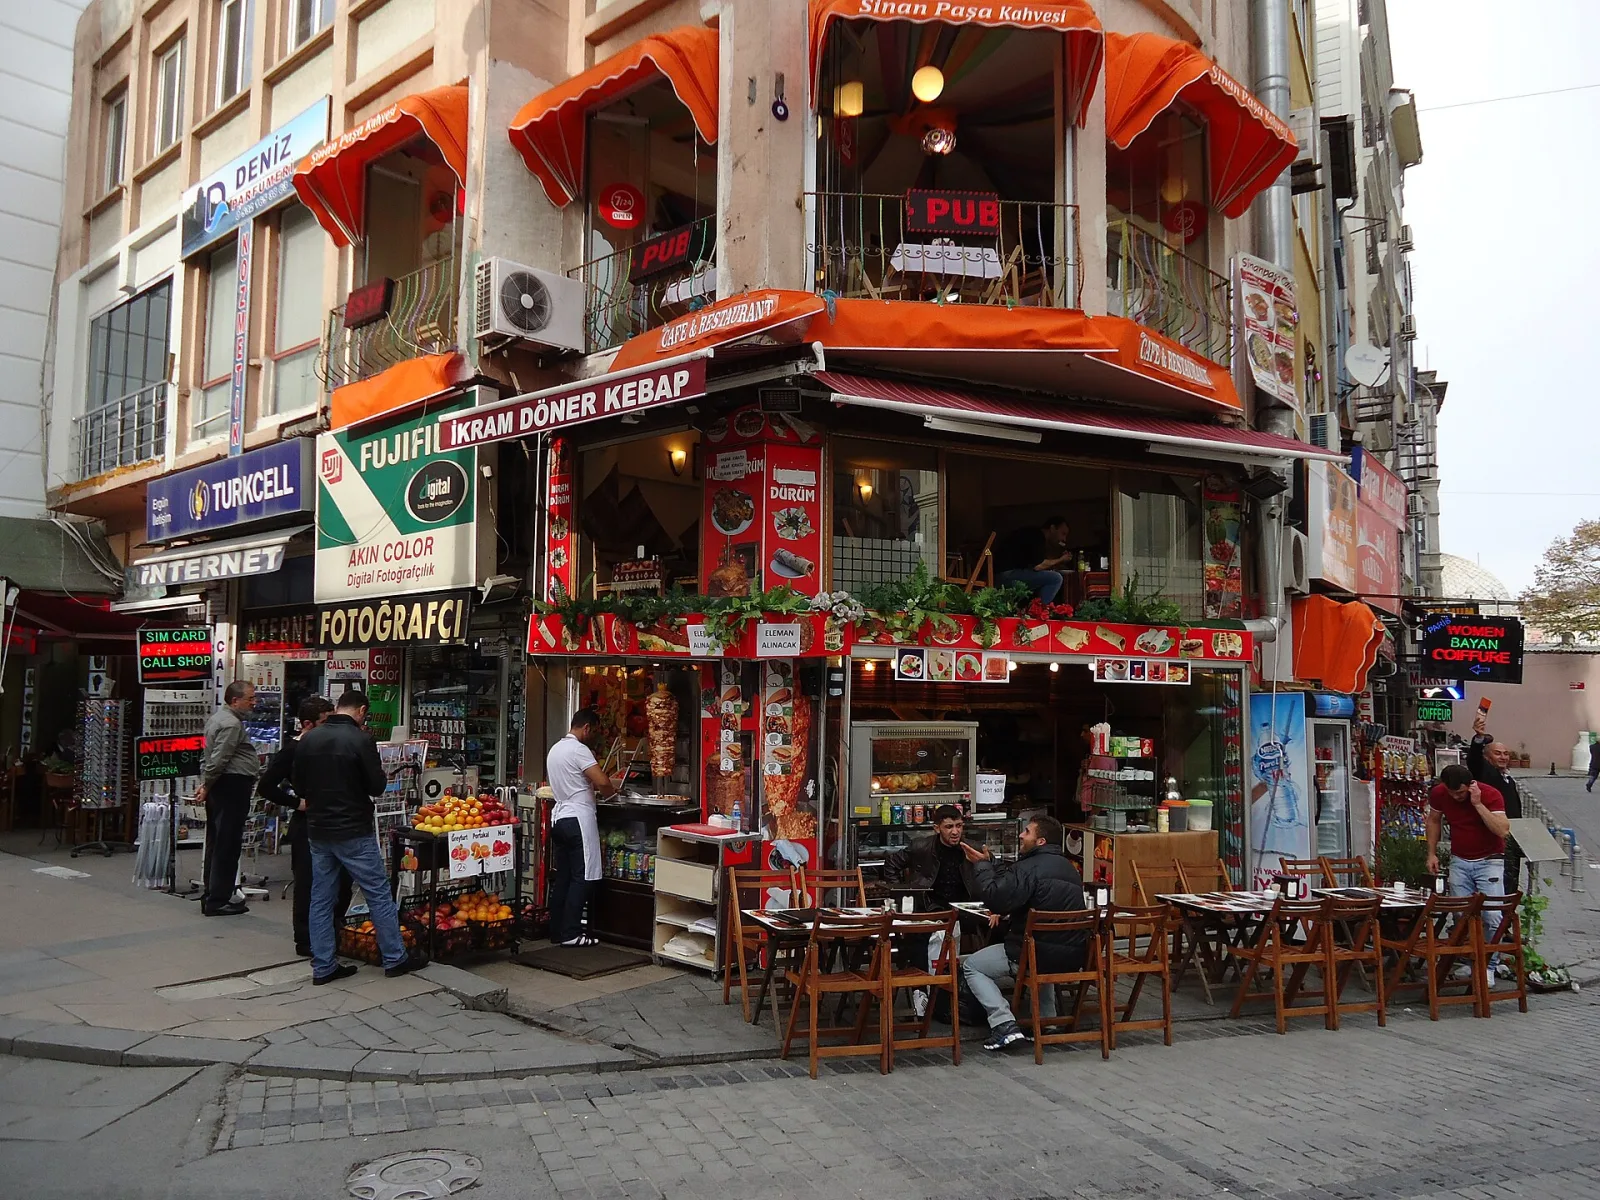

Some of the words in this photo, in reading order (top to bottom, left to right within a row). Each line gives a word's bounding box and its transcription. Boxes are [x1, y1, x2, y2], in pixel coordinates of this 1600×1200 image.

[858, 0, 927, 15] Sinan
[934, 1, 991, 20] Paşa
[999, 6, 1067, 23] Kahvesi
[1212, 65, 1240, 94] Sinan
[927, 198, 999, 227] PUB
[642, 231, 690, 269] PUB
[661, 322, 688, 348] CAFE
[689, 319, 697, 338] &
[698, 300, 774, 335] RESTAURANT
[1140, 338, 1161, 365] CAFE
[1167, 350, 1212, 386] RESTAURANT
[451, 411, 513, 446] İKRAM
[519, 391, 596, 430] DÖNER
[603, 370, 690, 412] KEBAP
[360, 422, 441, 472] FUJIFIL
[745, 457, 764, 475] RÜM
[212, 464, 294, 511] TURKCELL
[419, 474, 451, 500] digital
[770, 485, 815, 502] DÜRÜM
[348, 545, 380, 567] AKIN
[383, 536, 434, 562] COLOR
[347, 570, 375, 588] Digital
[377, 562, 435, 584] Fotoğrafçılık
[320, 600, 463, 644] FOTOĞRAFÇI
[1446, 625, 1505, 637] WOMEN
[146, 632, 169, 642] SIM
[172, 631, 206, 641] CARD
[765, 629, 794, 637] ELEMAN
[1450, 637, 1498, 650] BAYAN
[142, 657, 175, 668] CALL
[177, 656, 211, 667] SHOP
[327, 661, 345, 669] CALL
[1431, 648, 1511, 664] COIFFURE
[370, 666, 399, 680] color
[1417, 707, 1452, 721] COIFFEUR
[1386, 736, 1411, 746] BERBER
[140, 754, 177, 767] CALL
[478, 859, 486, 876] 1
